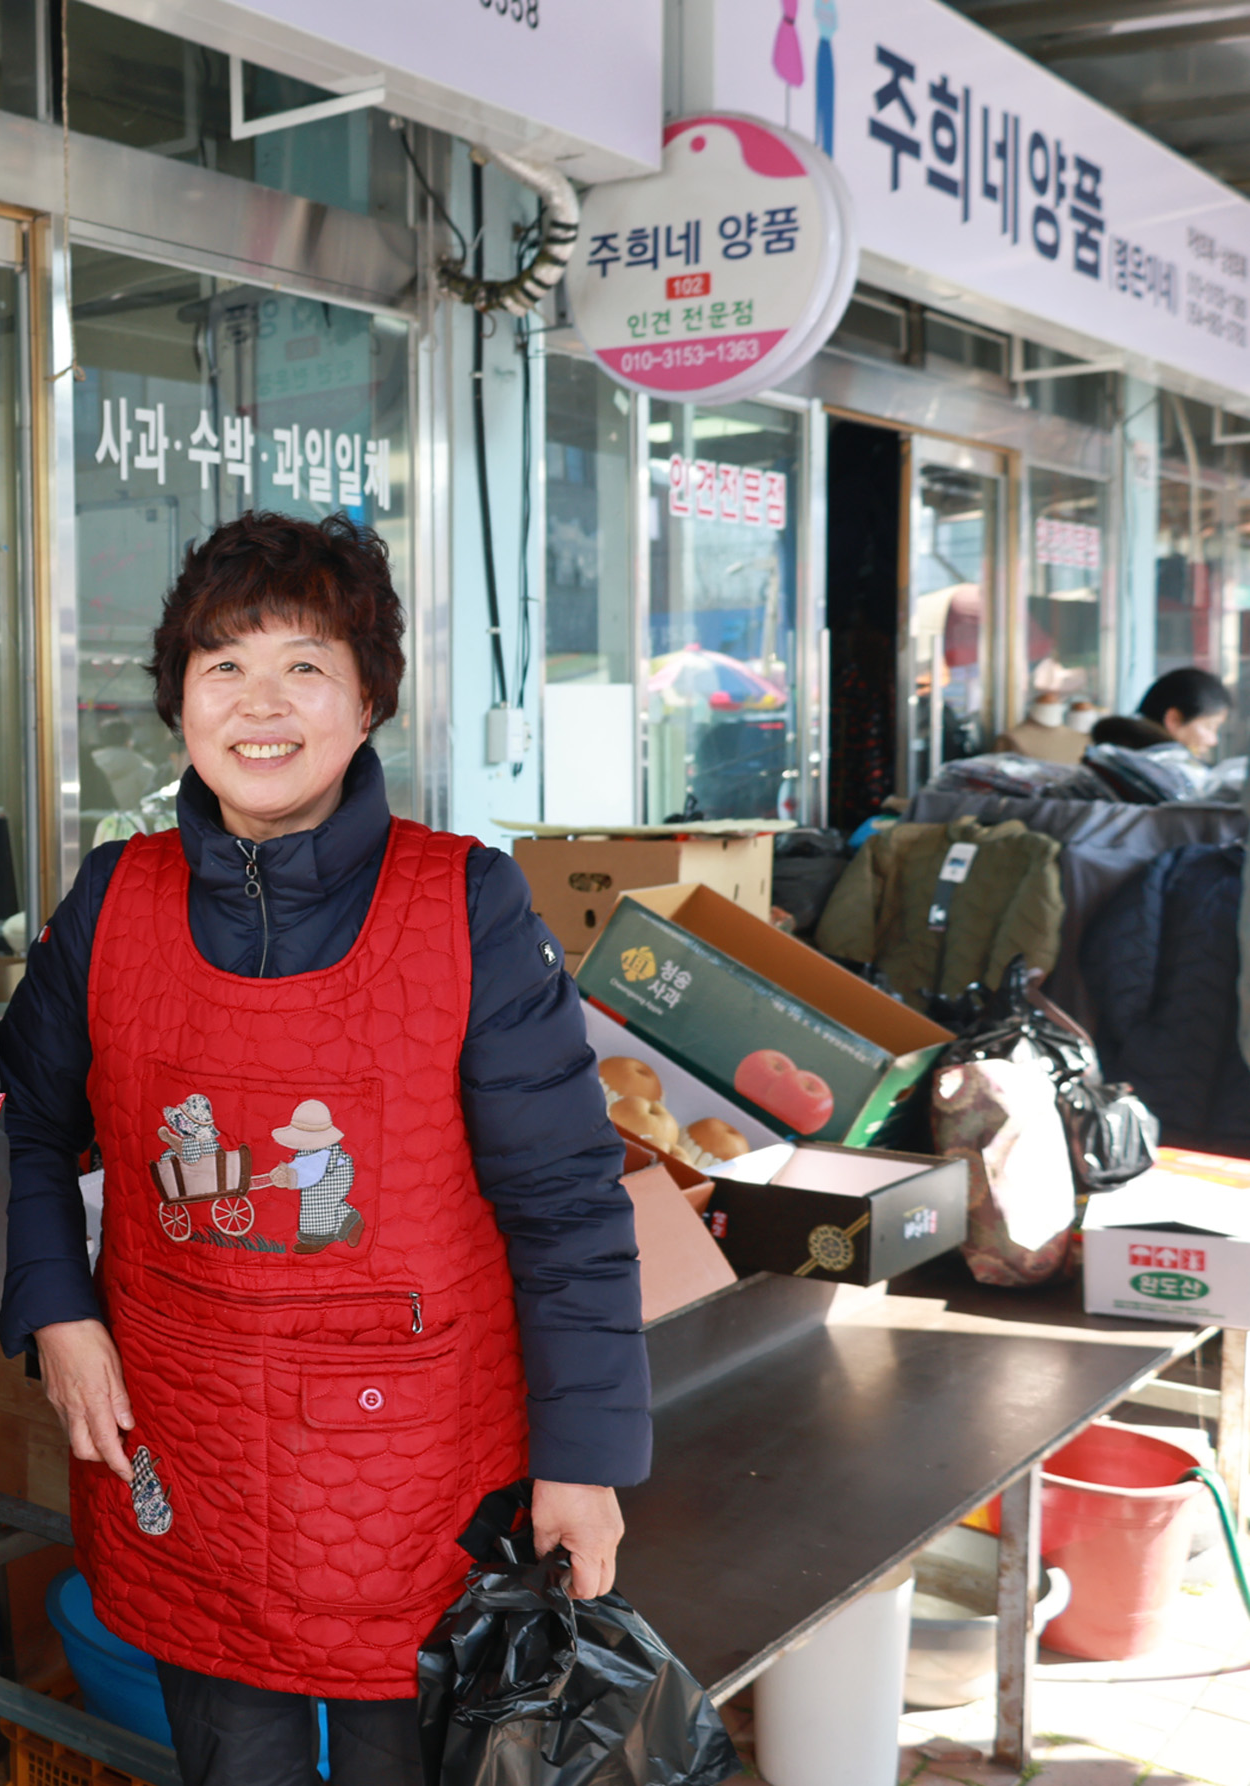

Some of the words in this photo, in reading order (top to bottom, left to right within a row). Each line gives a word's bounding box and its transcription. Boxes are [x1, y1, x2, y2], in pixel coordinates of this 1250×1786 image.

[868, 43, 1106, 280] 주희네양품
[587, 220, 701, 279] 주희네
[718, 206, 800, 260] 양품
[671, 276, 704, 297] 102
[626, 309, 672, 339] 인견
[682, 299, 755, 332] 전문점
[620, 338, 760, 373] 010-3153-1363
[669, 453, 787, 530] 인견전문점
[660, 959, 693, 991] 청송
[647, 979, 682, 1010] 사과
[1139, 1274, 1202, 1299] 완도산
